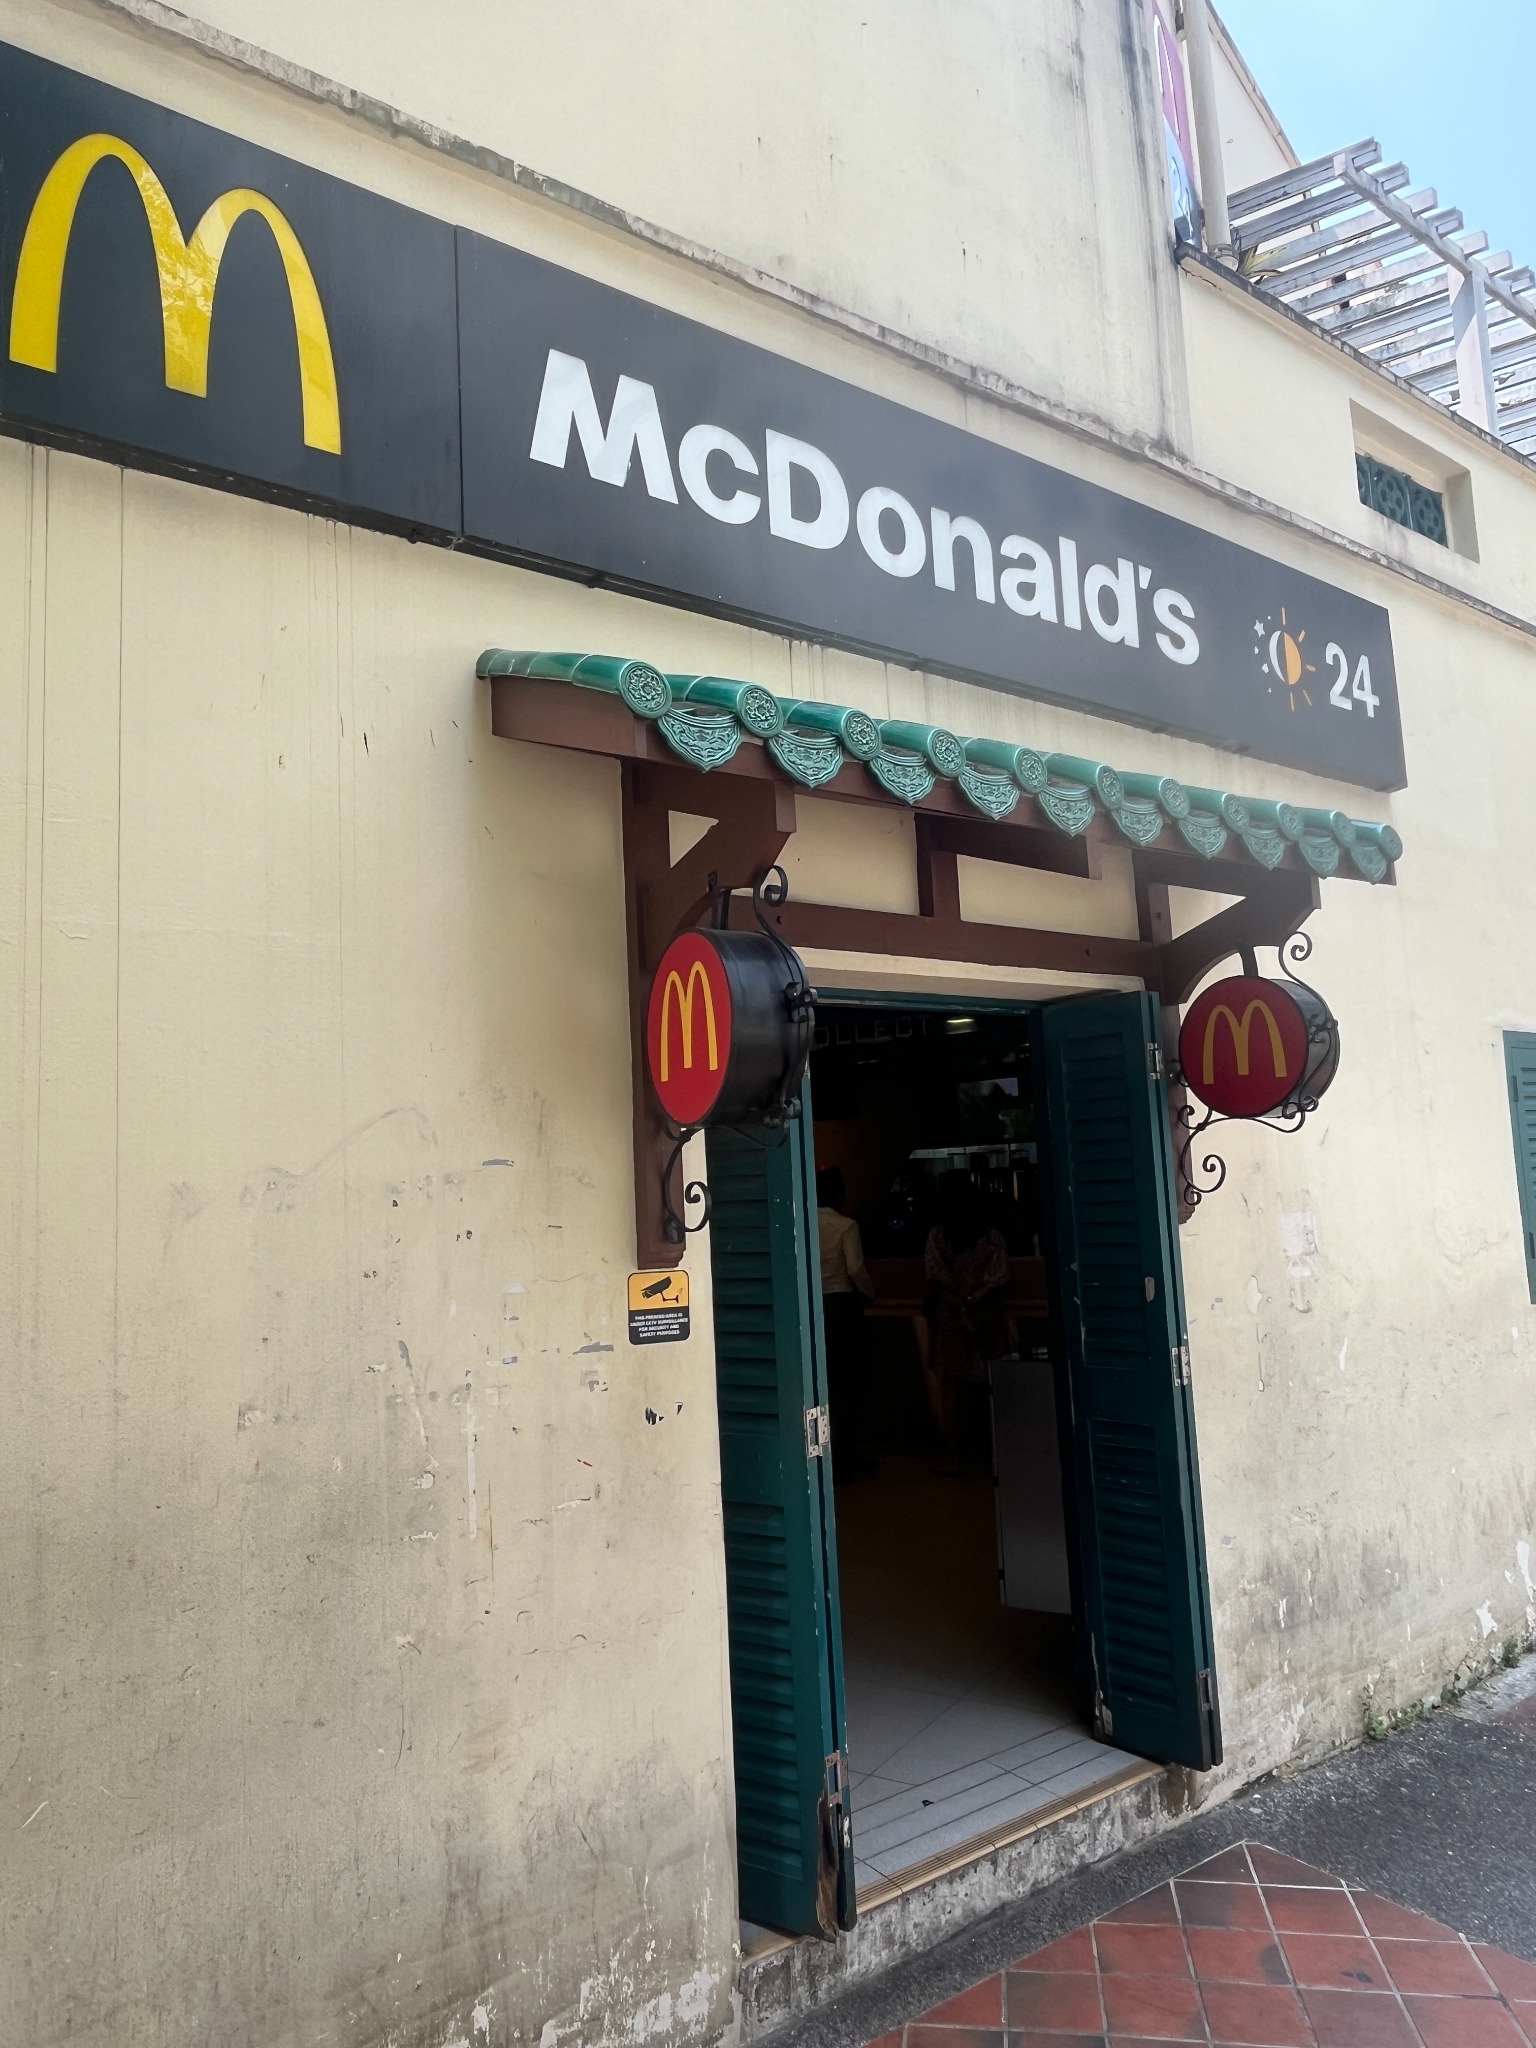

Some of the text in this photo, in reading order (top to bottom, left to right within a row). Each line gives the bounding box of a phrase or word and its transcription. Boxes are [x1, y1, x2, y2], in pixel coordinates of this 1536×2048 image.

[530, 349, 1200, 666] McDonald's
[1325, 642, 1380, 718] 24
[813, 1013, 932, 1048] OLLECT
